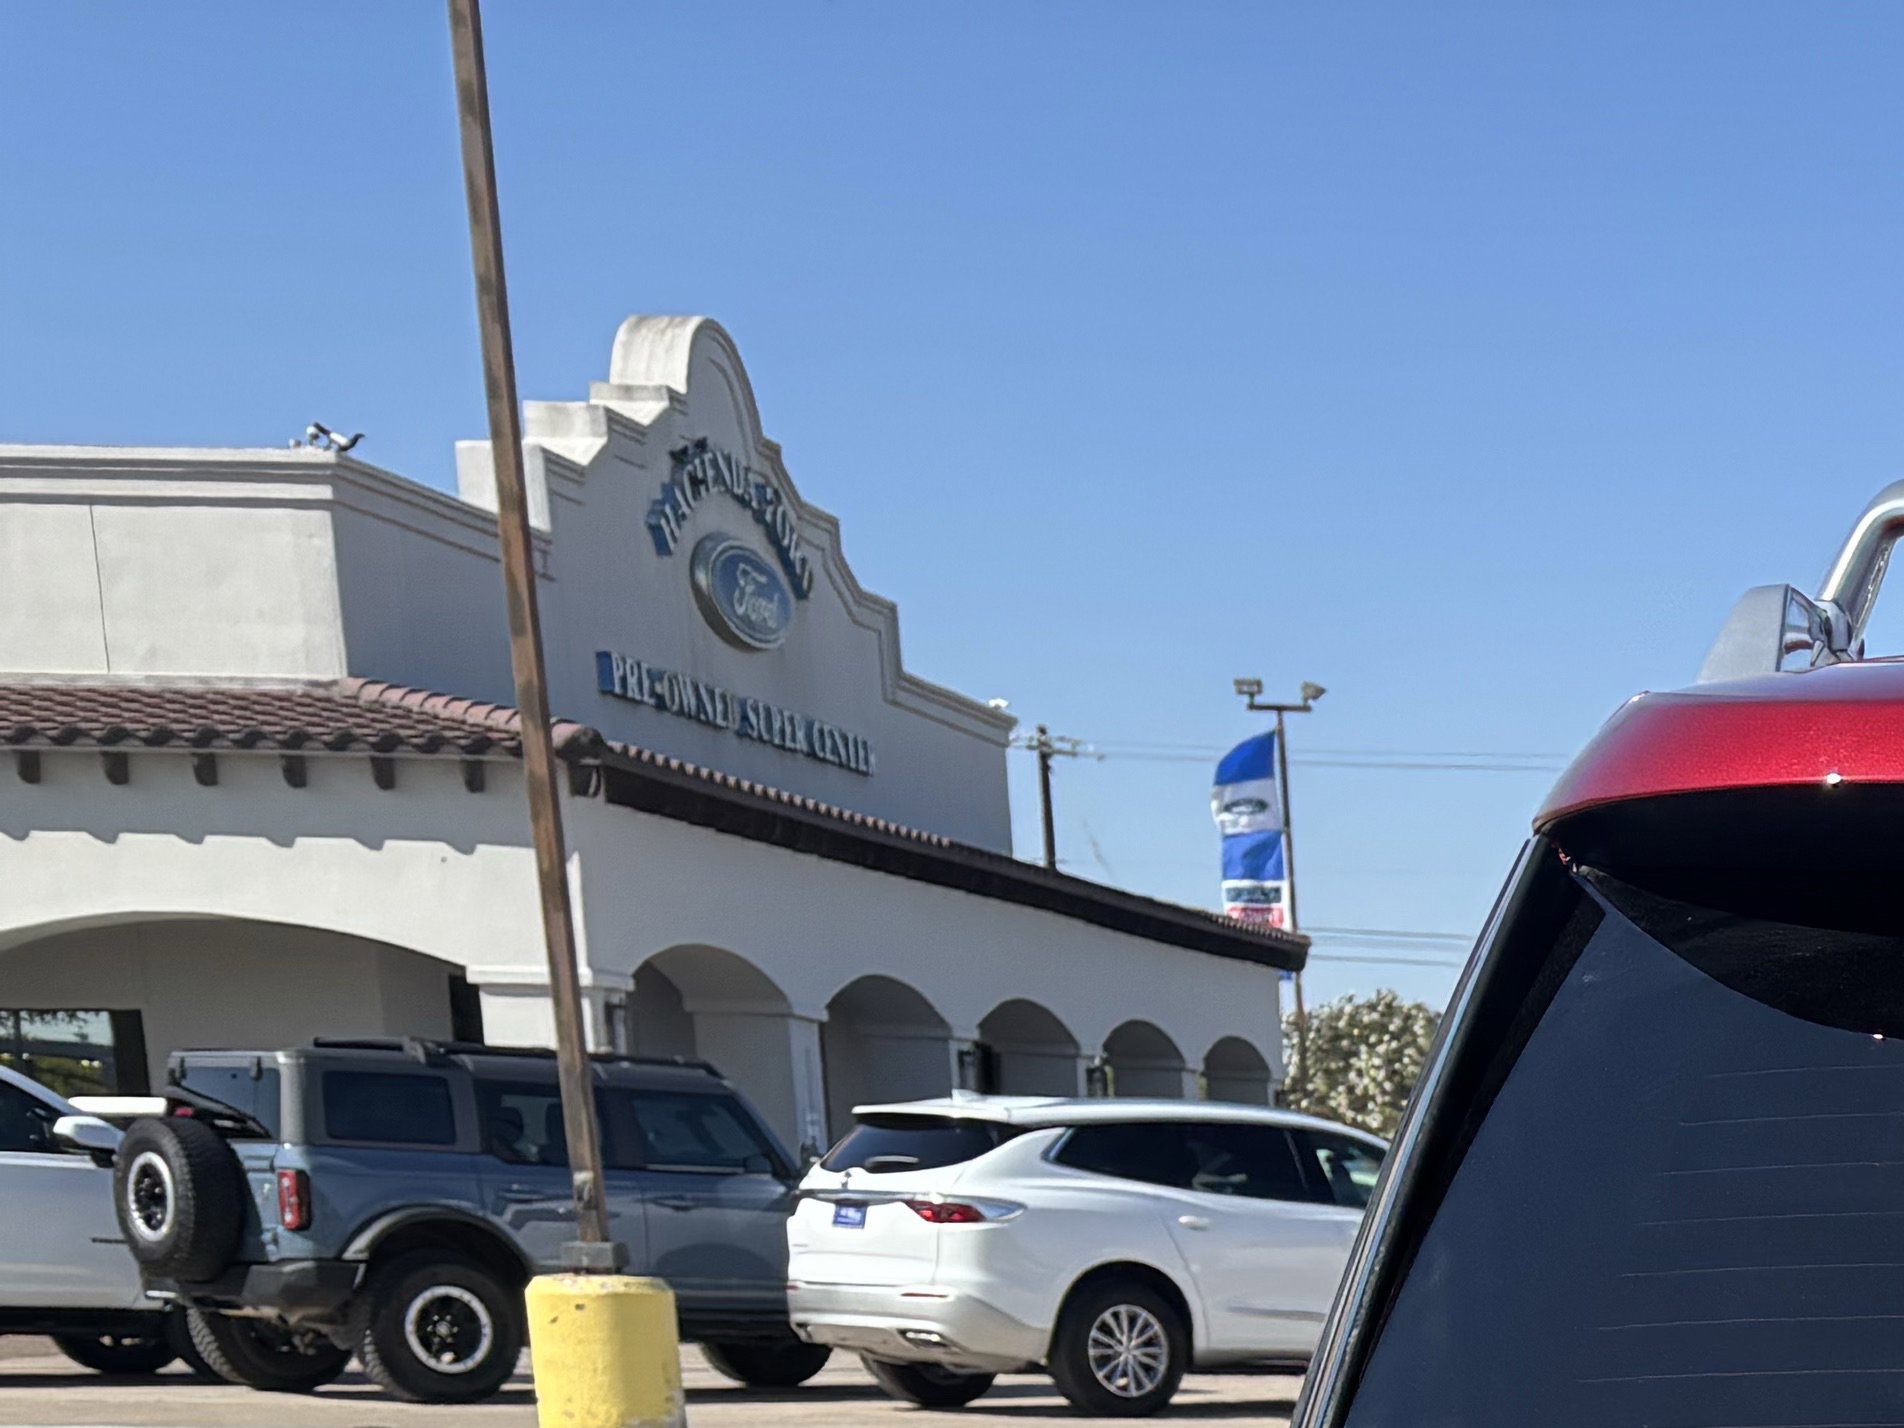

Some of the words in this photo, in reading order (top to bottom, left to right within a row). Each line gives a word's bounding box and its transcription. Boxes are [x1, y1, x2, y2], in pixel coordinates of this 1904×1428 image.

[732, 562, 780, 630] Ford
[611, 650, 742, 730] PRE-OWNED
[744, 697, 808, 752] SUPER
[812, 719, 876, 776] CENTER
